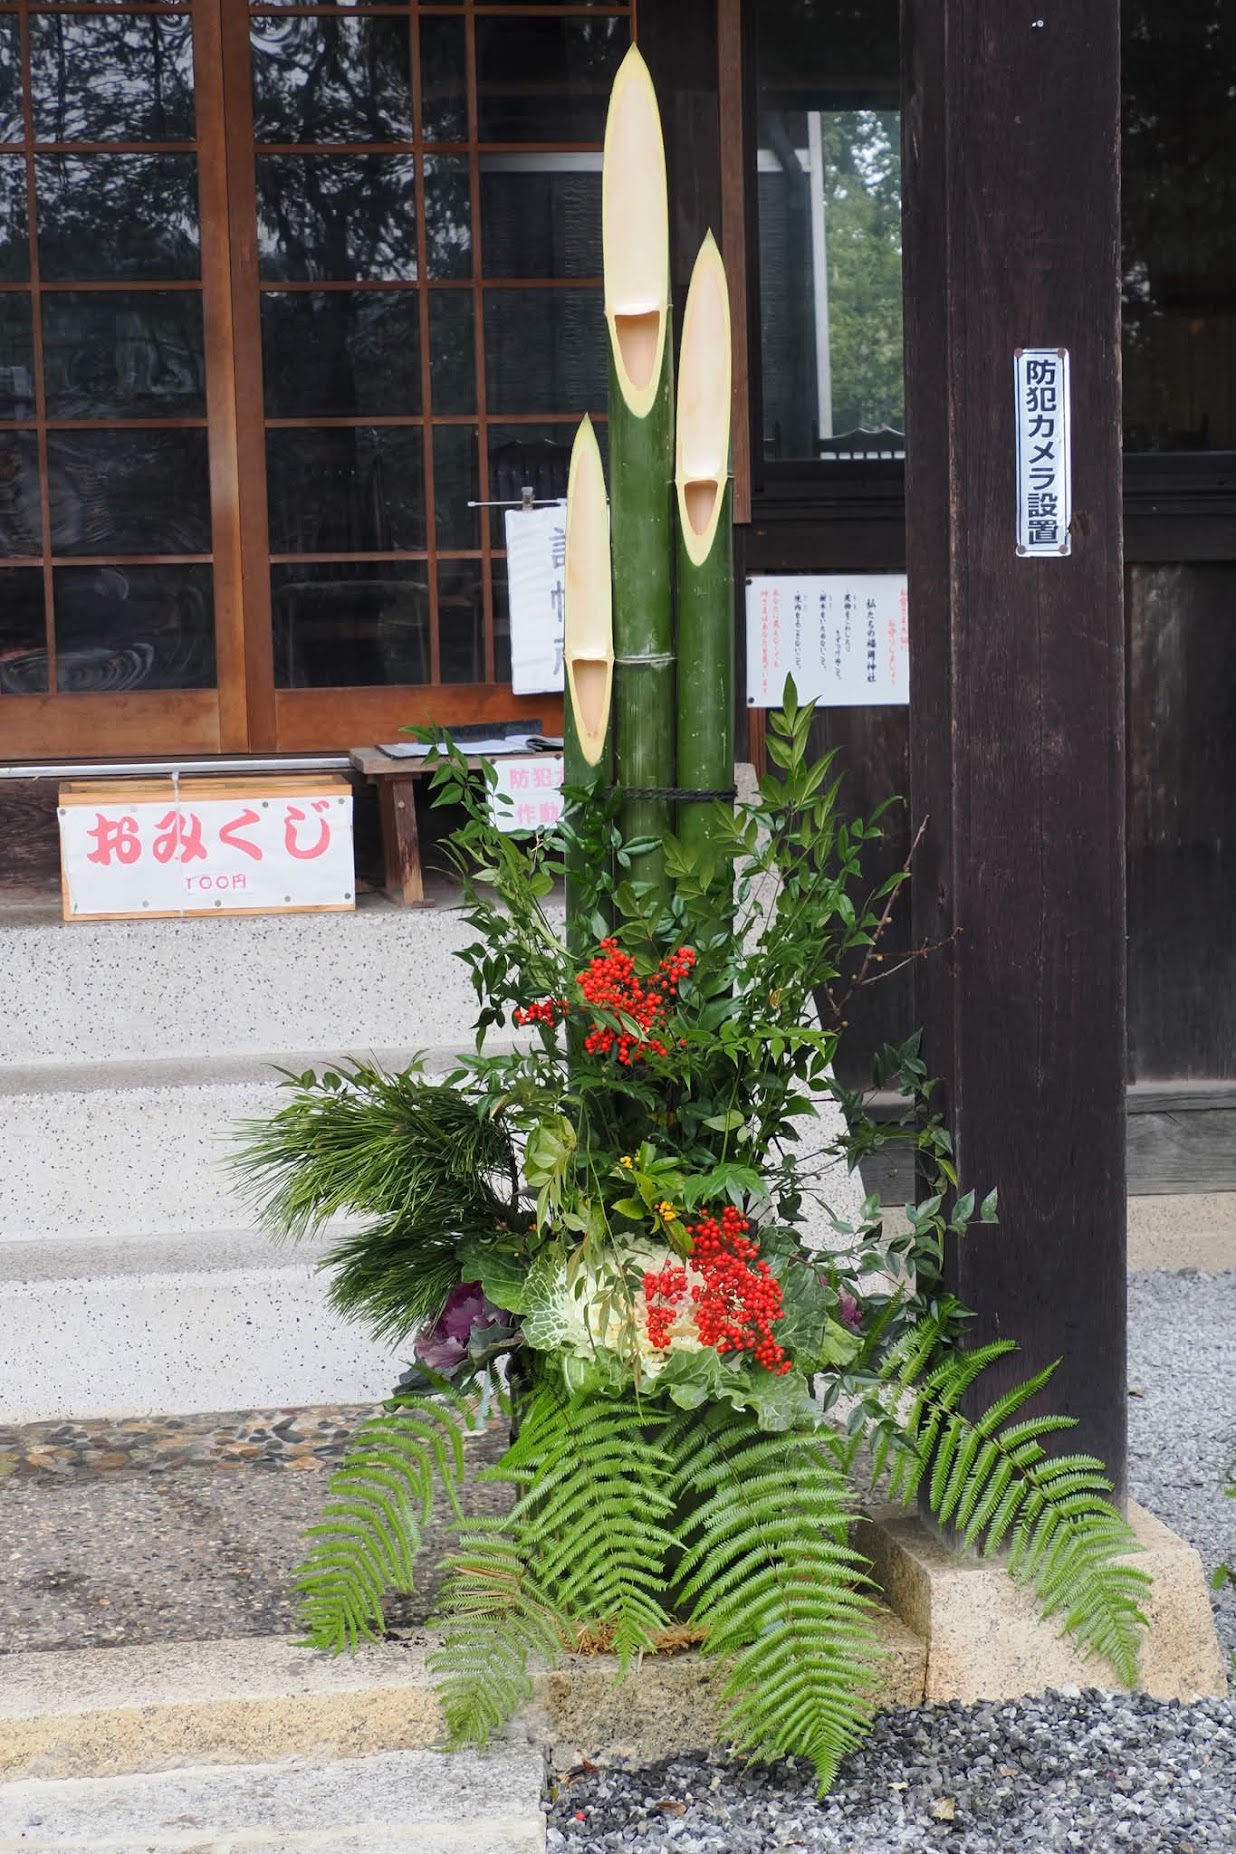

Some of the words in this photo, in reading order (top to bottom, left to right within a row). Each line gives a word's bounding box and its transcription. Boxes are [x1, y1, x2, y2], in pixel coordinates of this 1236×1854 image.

[1026, 359, 1058, 545] 防犯カメラ設置
[866, 598, 877, 683] 私たちの福岡神社
[86, 799, 331, 866] おみくじ
[185, 873, 247, 890] 100円
